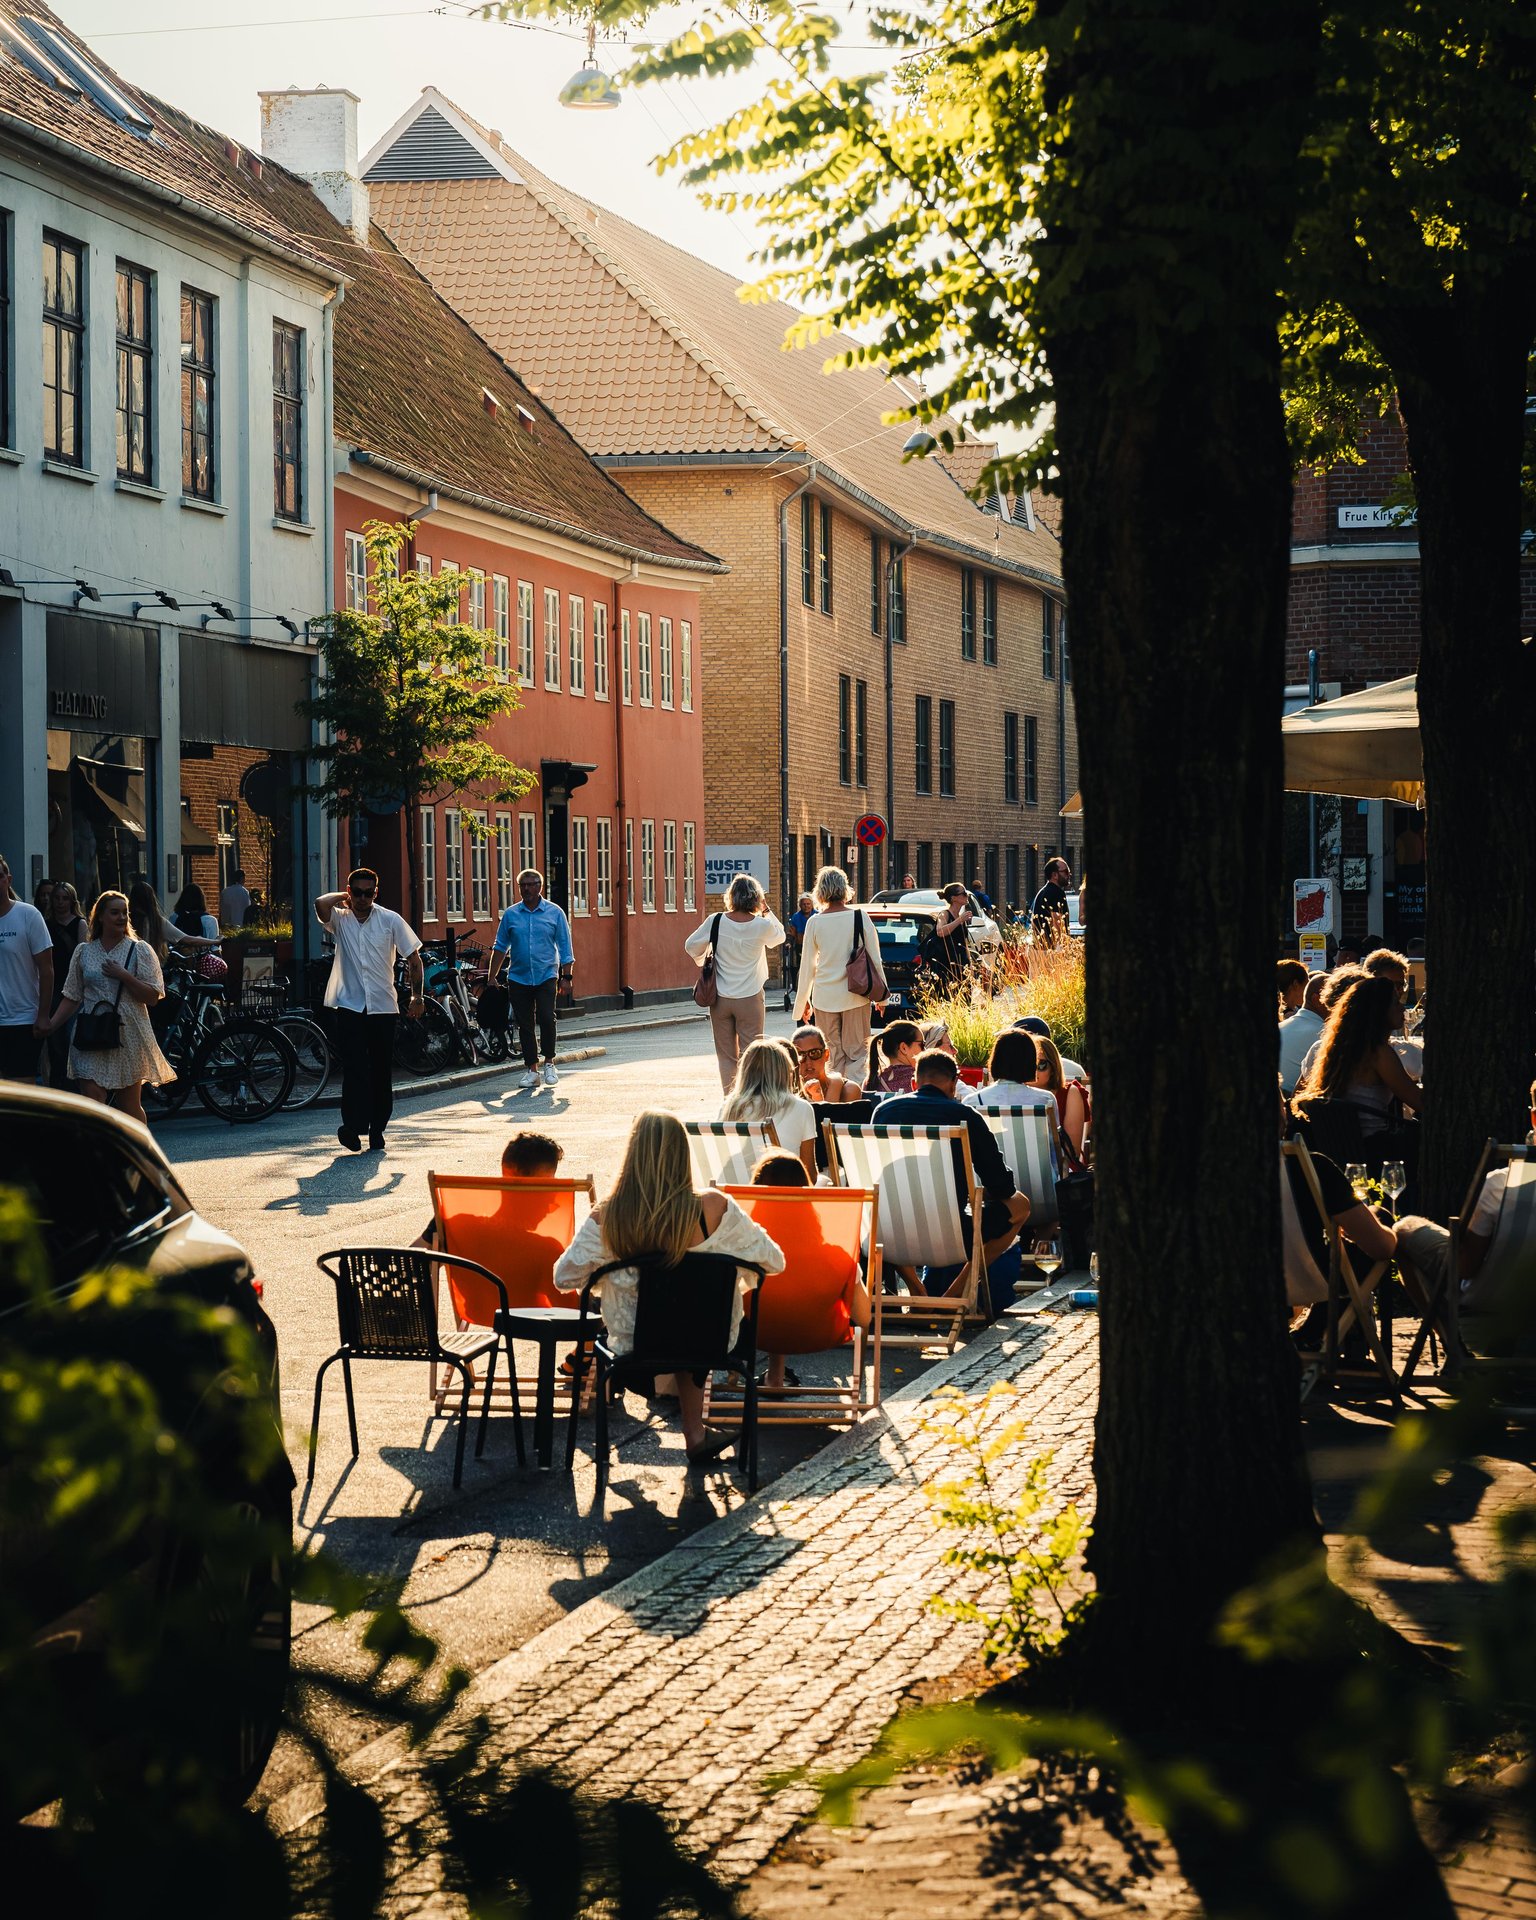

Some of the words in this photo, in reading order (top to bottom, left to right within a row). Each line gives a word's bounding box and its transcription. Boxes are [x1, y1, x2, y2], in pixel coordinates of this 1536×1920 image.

[1345, 511, 1368, 521] Frue
[554, 856, 563, 864] 21
[705, 859, 752, 871] HUSET
[1398, 885, 1413, 896] My
[1398, 895, 1413, 904] life
[1415, 895, 1424, 904] is
[1398, 905, 1424, 913] drink
